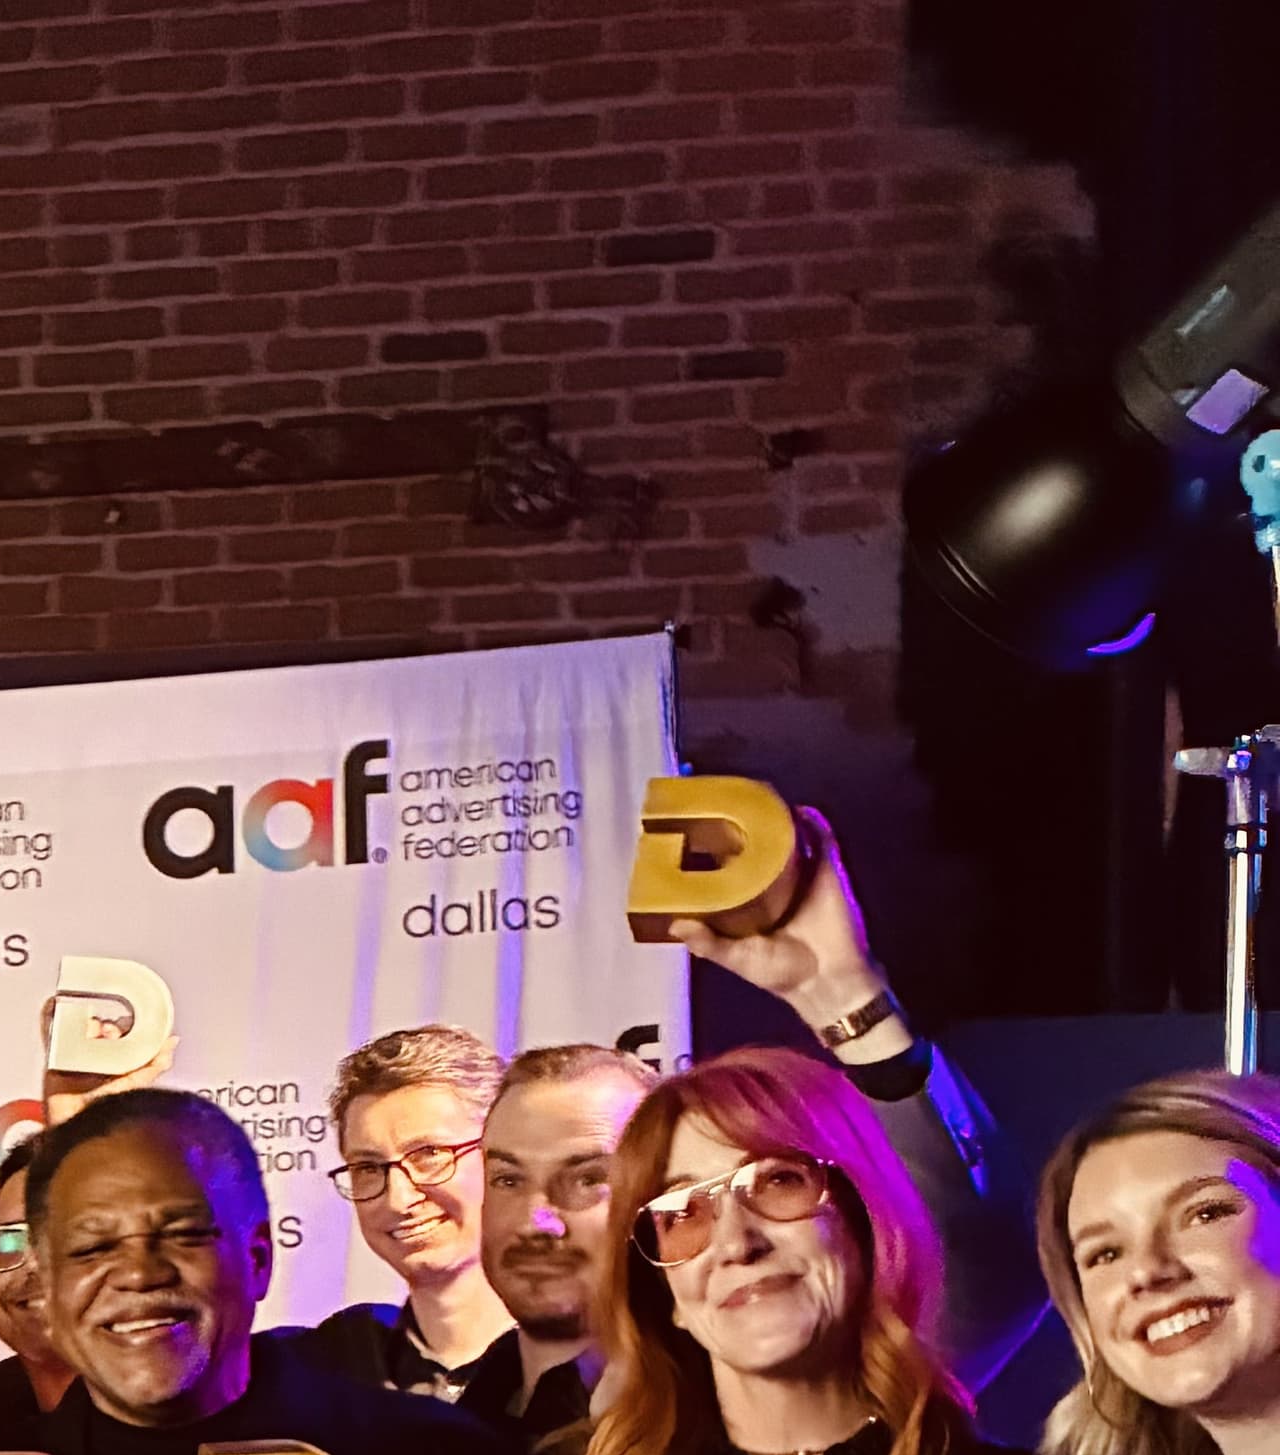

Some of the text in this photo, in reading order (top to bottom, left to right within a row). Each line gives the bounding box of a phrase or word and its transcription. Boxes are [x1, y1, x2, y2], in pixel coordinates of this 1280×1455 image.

[400, 756, 556, 793] american
[142, 739, 389, 879] aaf
[401, 789, 583, 826] advertising
[403, 824, 574, 860] federation
[402, 889, 561, 938] dallas
